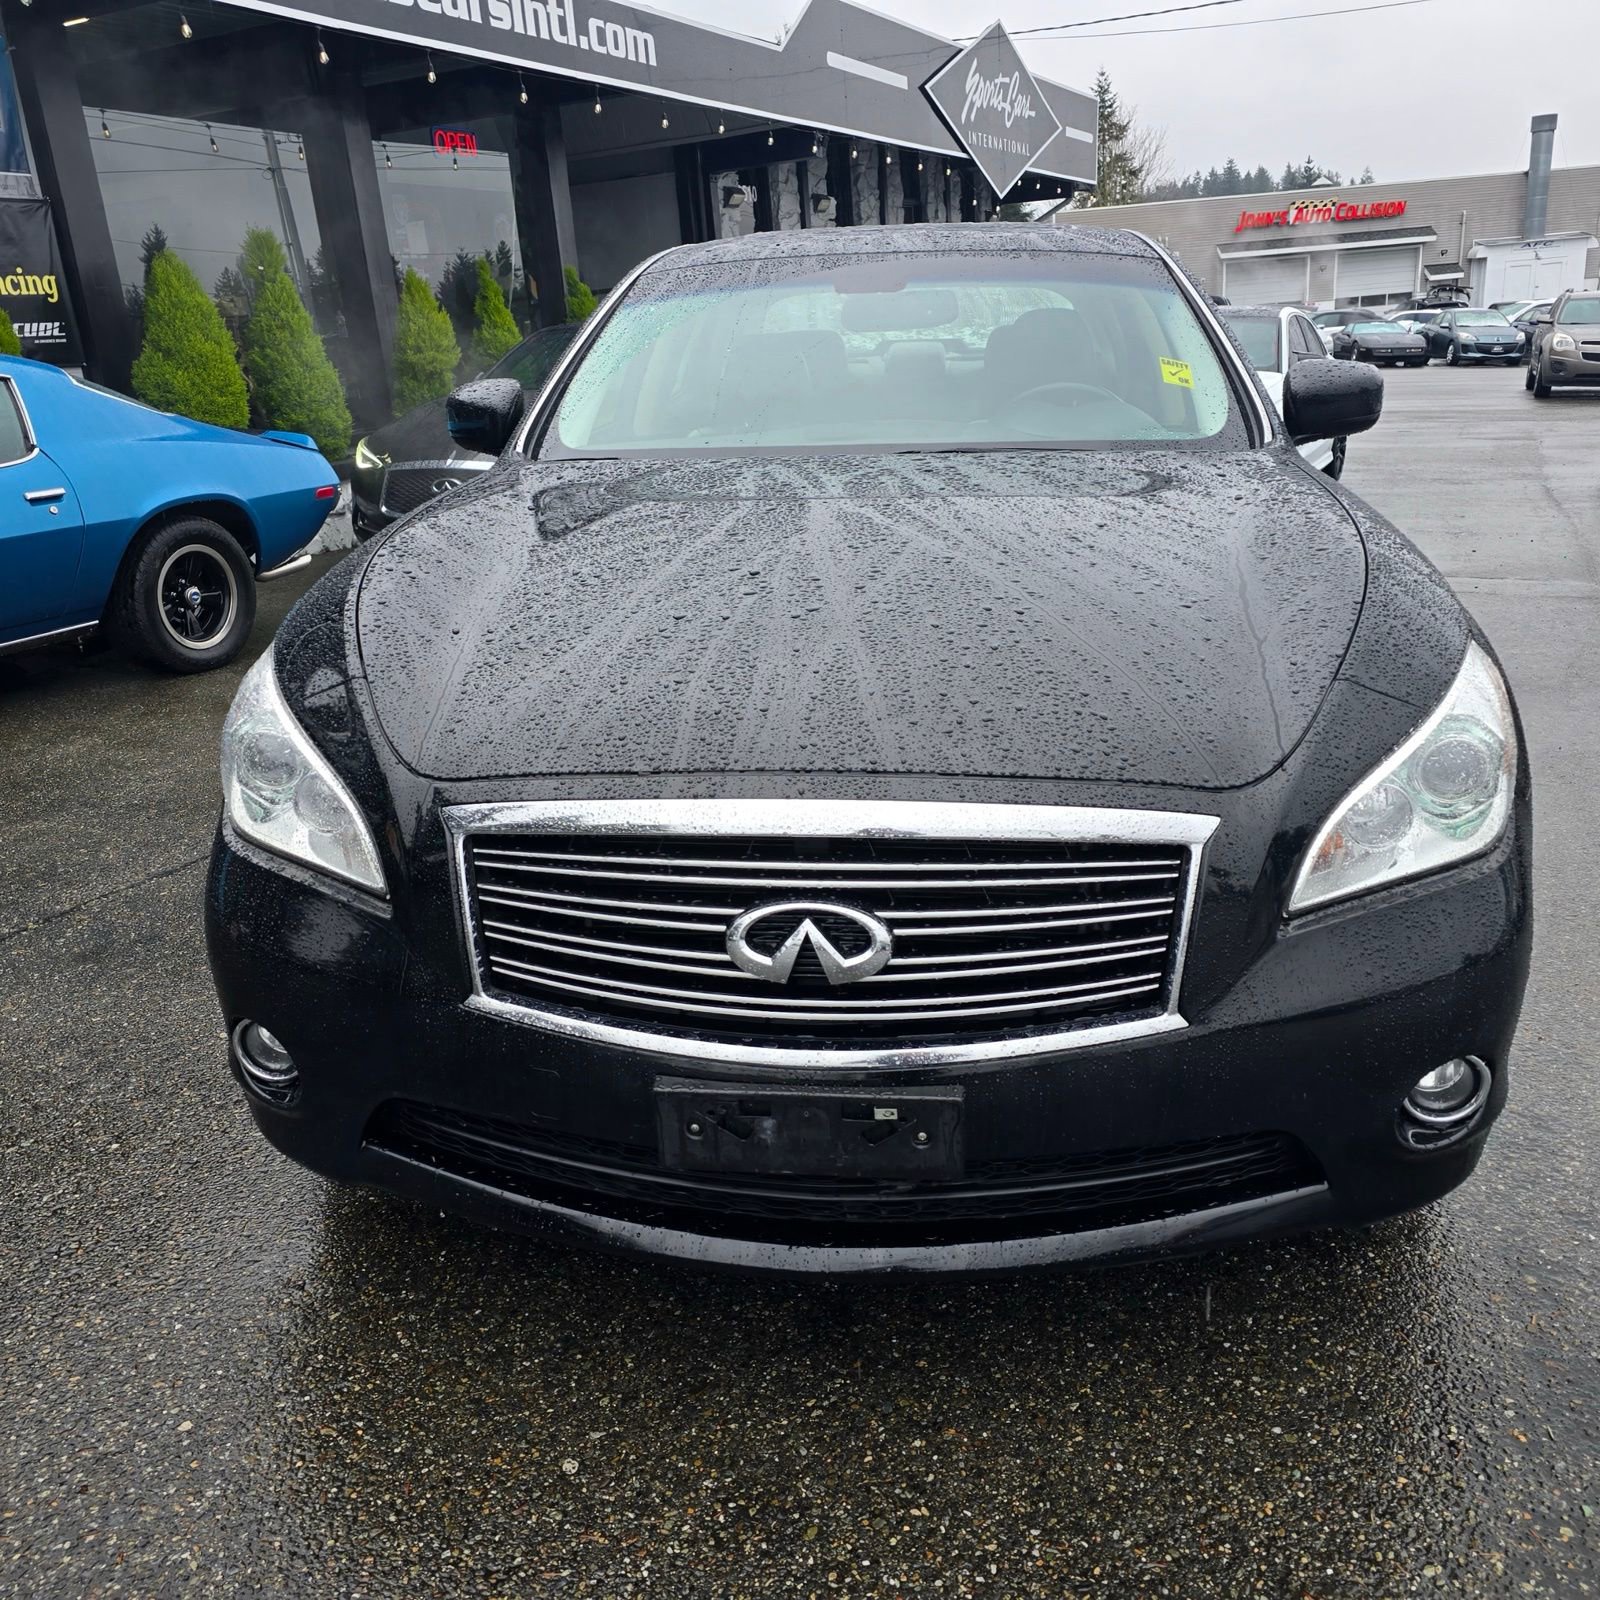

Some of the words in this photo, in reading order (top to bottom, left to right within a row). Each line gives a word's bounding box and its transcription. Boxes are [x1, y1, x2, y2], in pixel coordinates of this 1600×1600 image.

[961, 57, 1010, 125] Sports
[1004, 71, 1036, 128] Cars
[433, 129, 478, 157] OPEN
[968, 131, 1030, 156] INTERNATIONAL
[1233, 209, 1289, 234] JOHN'S
[1292, 204, 1333, 225] AUTO
[1335, 200, 1407, 222] COLLISION
